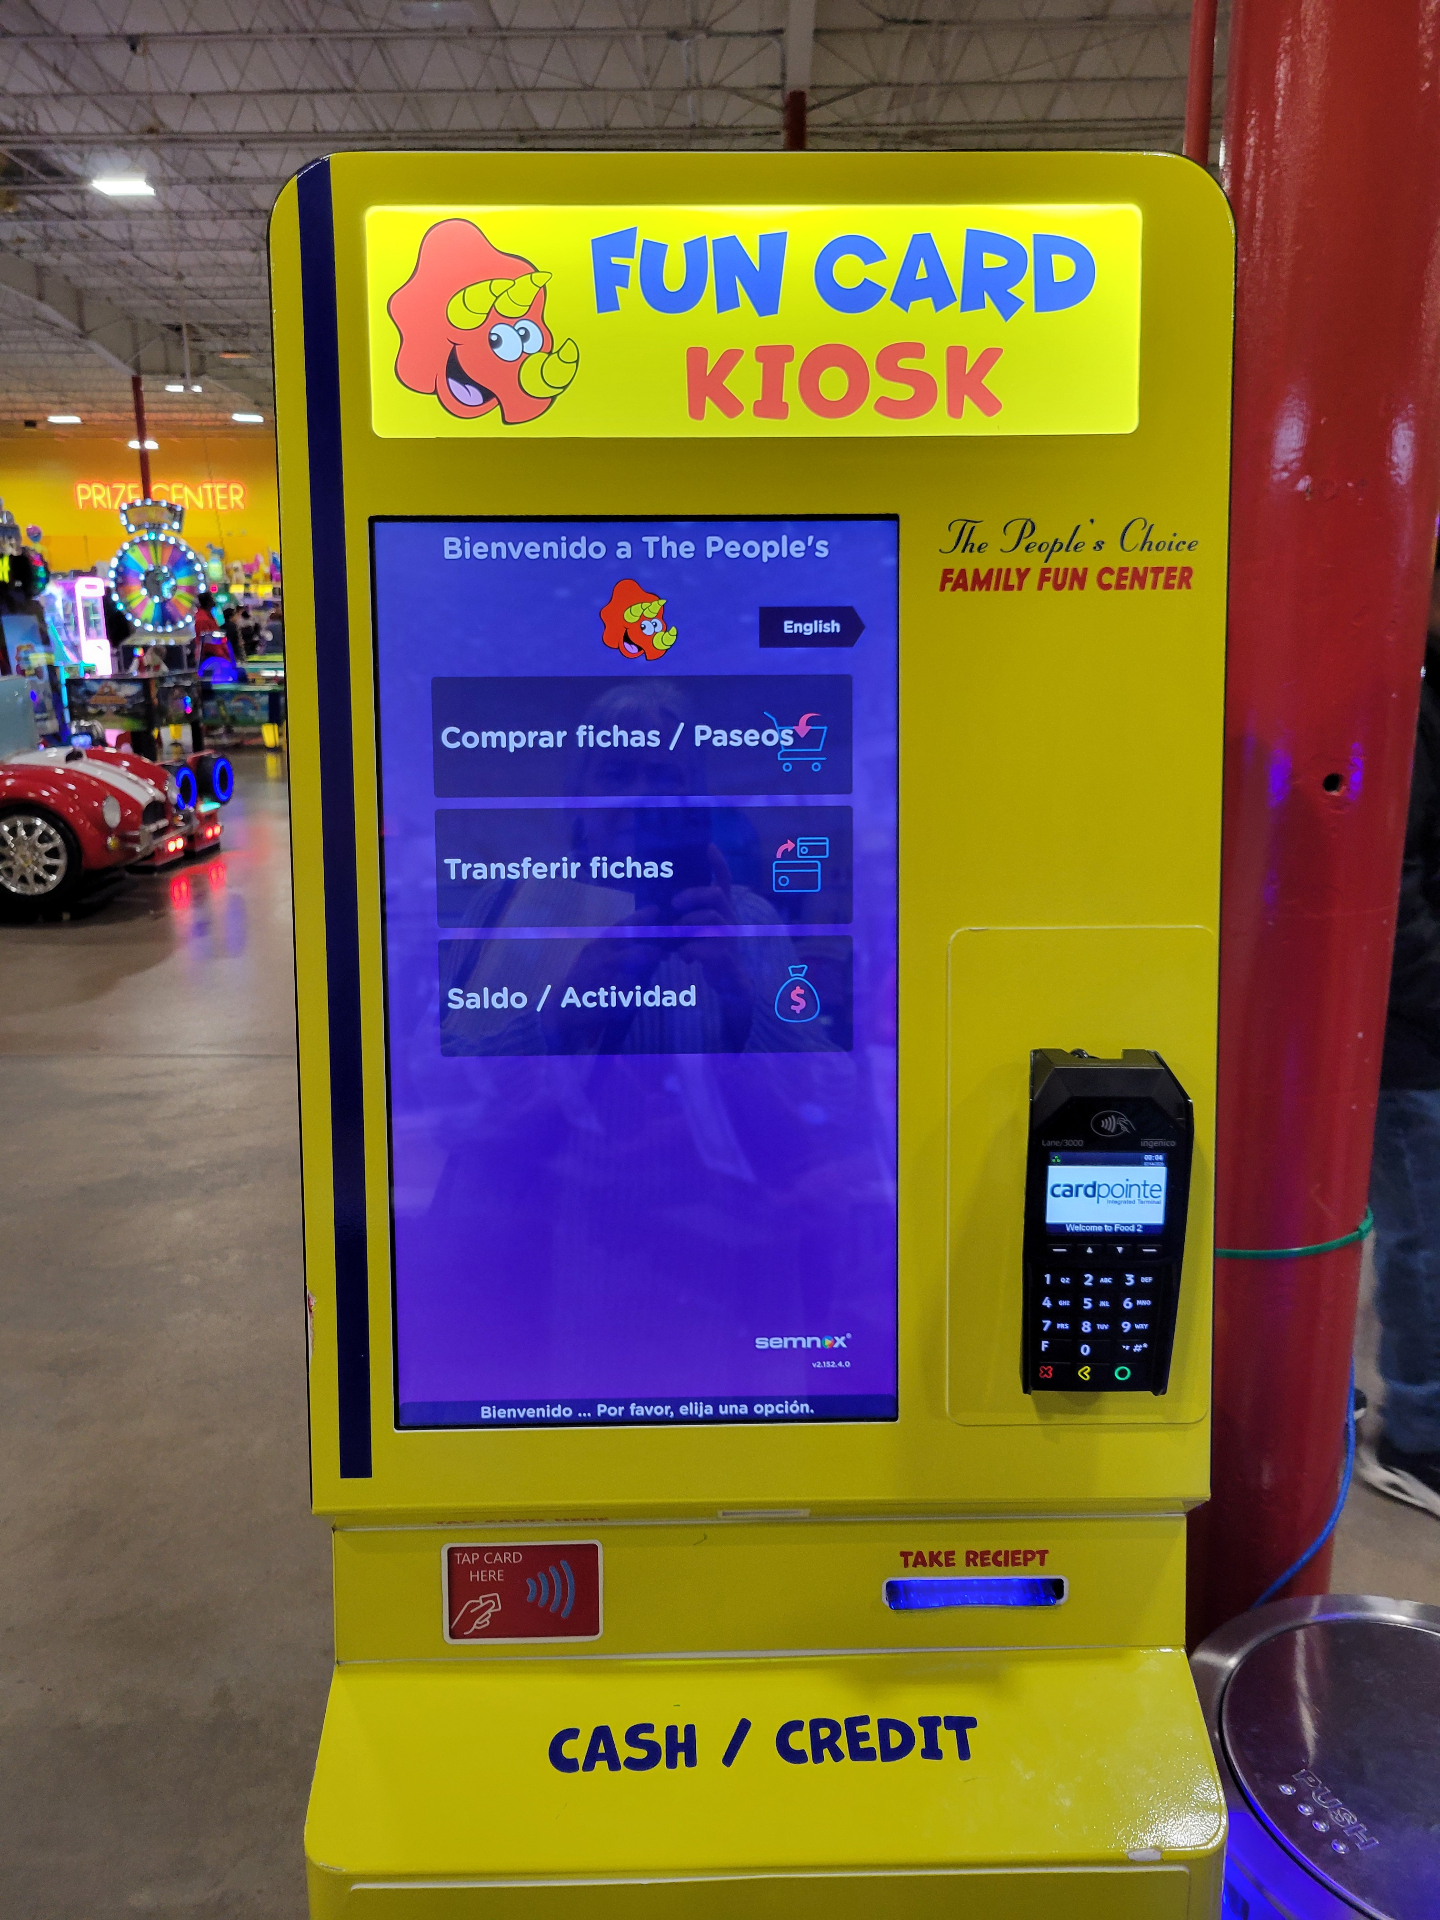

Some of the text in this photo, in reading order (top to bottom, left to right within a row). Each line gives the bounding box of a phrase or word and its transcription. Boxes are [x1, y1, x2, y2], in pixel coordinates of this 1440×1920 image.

[591, 226, 1096, 322] FUN CARD
[686, 342, 1006, 421] KIOSK
[76, 482, 140, 509] PRIZE
[443, 535, 829, 562] Bienvenido a The People's
[939, 517, 1199, 563] The People's Choice
[938, 566, 1194, 592] FAMILY FUN CENTER
[783, 620, 841, 636] English
[441, 722, 795, 753] Comprar fichas / Paseos
[444, 855, 674, 880] Transferir fichas
[447, 984, 697, 1012] Saldo / Actividad
[1041, 1139, 1084, 1148] Lane/3000
[1140, 1138, 1177, 1149] ingenico
[1050, 1178, 1162, 1204] cardpointe
[1065, 1223, 1143, 1232] Welcome to Food 2
[1044, 1273, 1052, 1285] 1
[1083, 1273, 1094, 1286] 2
[1124, 1273, 1135, 1286] 3
[1041, 1296, 1053, 1308] 4
[1082, 1297, 1093, 1310] 5
[1122, 1297, 1134, 1310] 6
[1041, 1320, 1052, 1332] 7
[1081, 1320, 1092, 1333] 8
[1121, 1321, 1132, 1333] 9
[1041, 1340, 1050, 1352] F
[1080, 1344, 1091, 1356] 0
[812, 1360, 851, 1368] v2.152.4.0
[480, 1405, 573, 1419] Bienvenido
[597, 1403, 625, 1417] Por
[629, 1402, 674, 1418] favor,
[679, 1401, 714, 1418] elija
[719, 1405, 749, 1416] una
[753, 1400, 815, 1417] opción.
[454, 1551, 523, 1565] TAP CARD
[899, 1549, 1049, 1569] TAKE RECIEPT
[469, 1570, 504, 1582] HERE
[548, 1714, 978, 1774] CASH / CREDIT
[1292, 1768, 1380, 1850] PUSH
